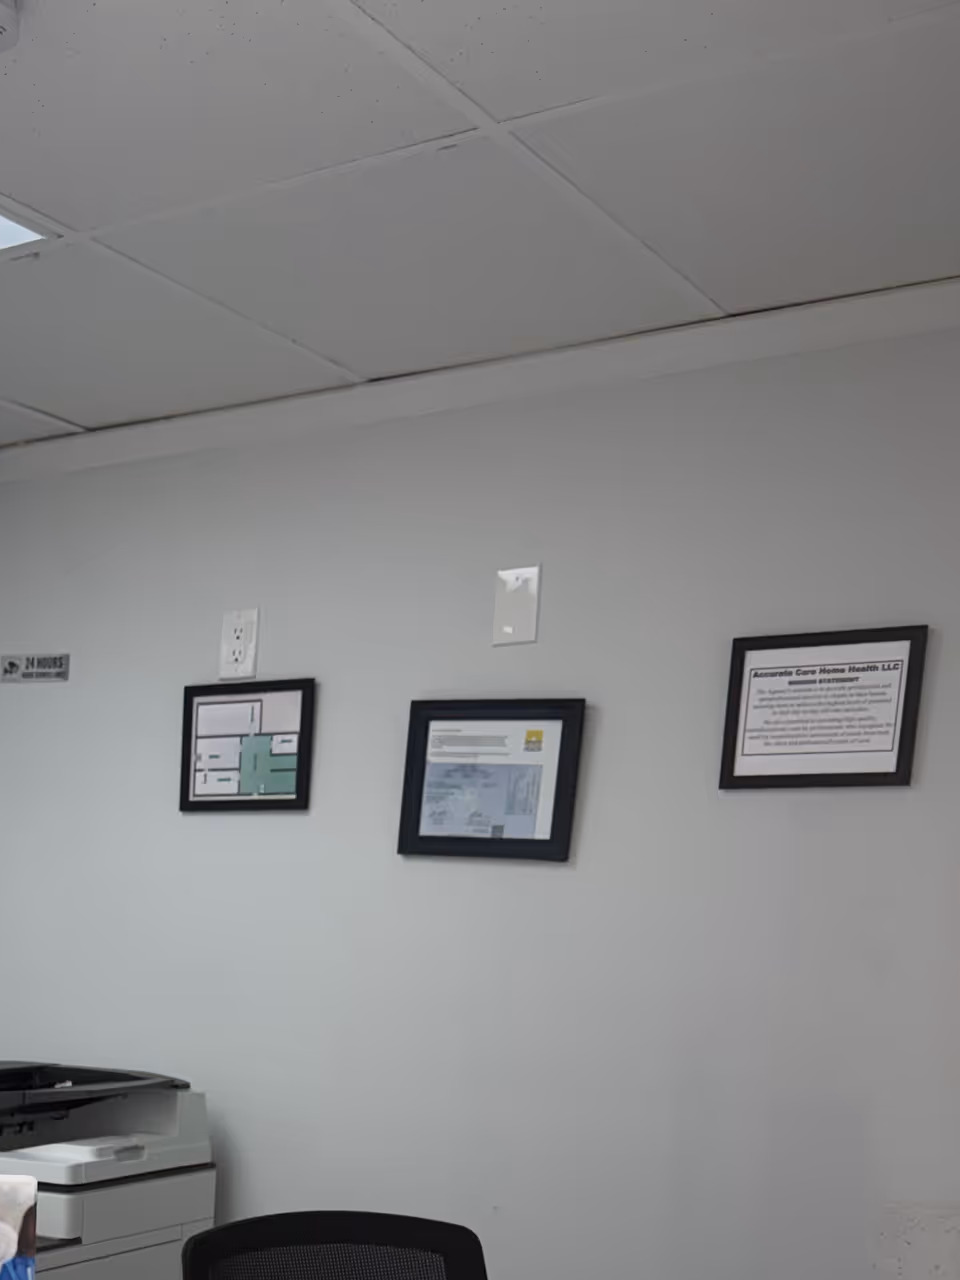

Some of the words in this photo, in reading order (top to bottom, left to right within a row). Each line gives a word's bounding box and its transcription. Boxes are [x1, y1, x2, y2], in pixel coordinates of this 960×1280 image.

[753, 669, 793, 678] Accurate
[795, 668, 817, 676] Care
[819, 667, 846, 675] Home
[848, 665, 879, 673] Health
[881, 663, 900, 671] LLC
